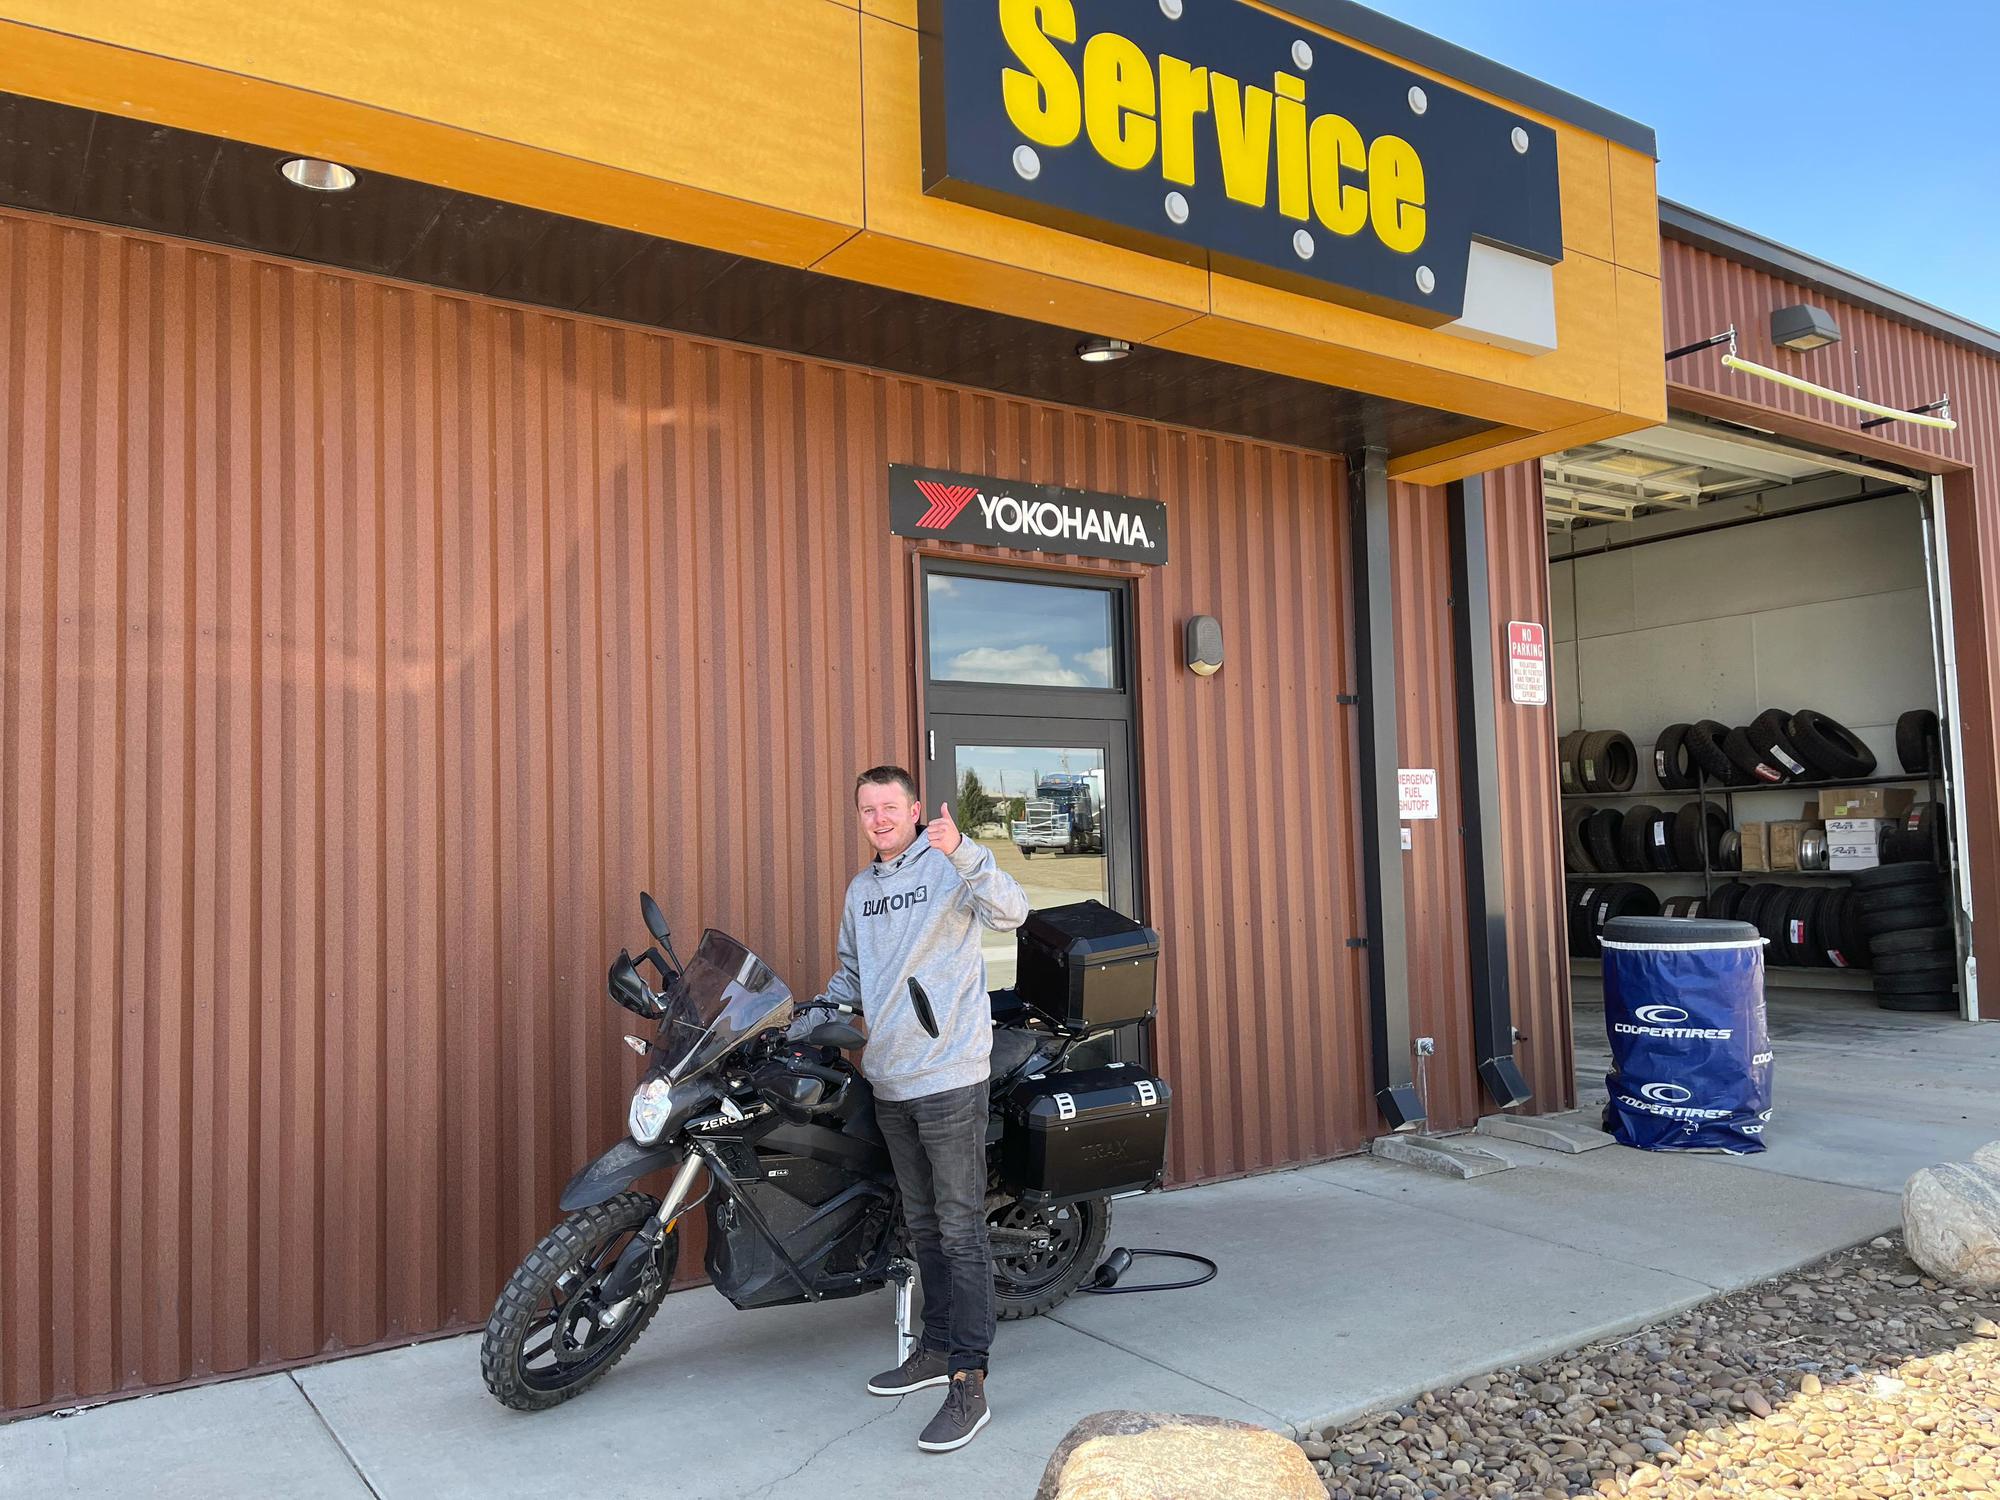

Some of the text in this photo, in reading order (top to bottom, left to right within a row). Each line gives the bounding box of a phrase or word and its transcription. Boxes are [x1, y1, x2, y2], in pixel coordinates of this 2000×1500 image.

[1000, 0, 1427, 253] Service
[977, 493, 1149, 548] YOKOHAMA
[1521, 628, 1532, 641] NO
[1512, 641, 1543, 657] PARKING
[1404, 787, 1423, 798] FUEL
[1399, 799, 1430, 811] SHUTOFF
